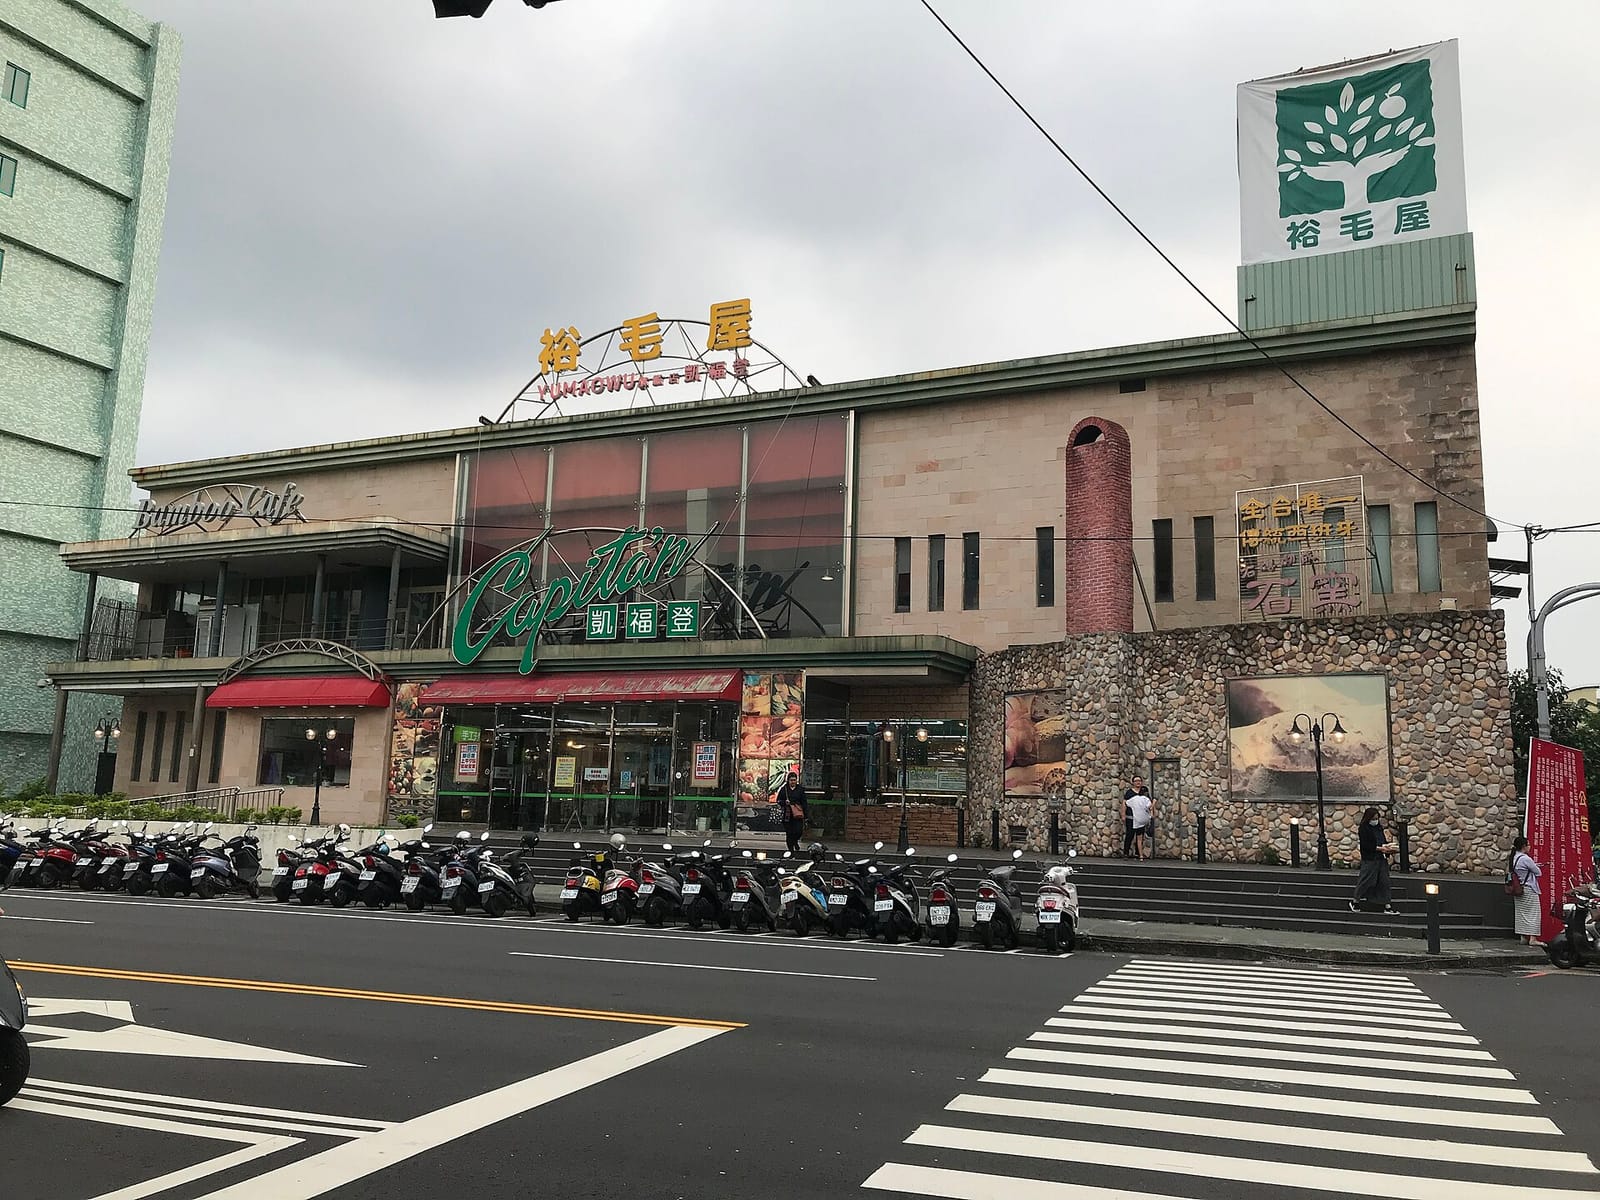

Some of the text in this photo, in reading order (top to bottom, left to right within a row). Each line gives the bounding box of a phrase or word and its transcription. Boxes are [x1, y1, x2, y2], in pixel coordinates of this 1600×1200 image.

[1287, 200, 1430, 251] 裕毛屋
[538, 298, 753, 375] 裕毛屋
[537, 372, 639, 401] YUMAOWU
[132, 490, 238, 529] Bamboo
[1239, 490, 1359, 522] 全台唯一
[1246, 570, 1363, 616] 石窯
[589, 605, 695, 636] 凱福登
[1578, 790, 1589, 832] 公告
